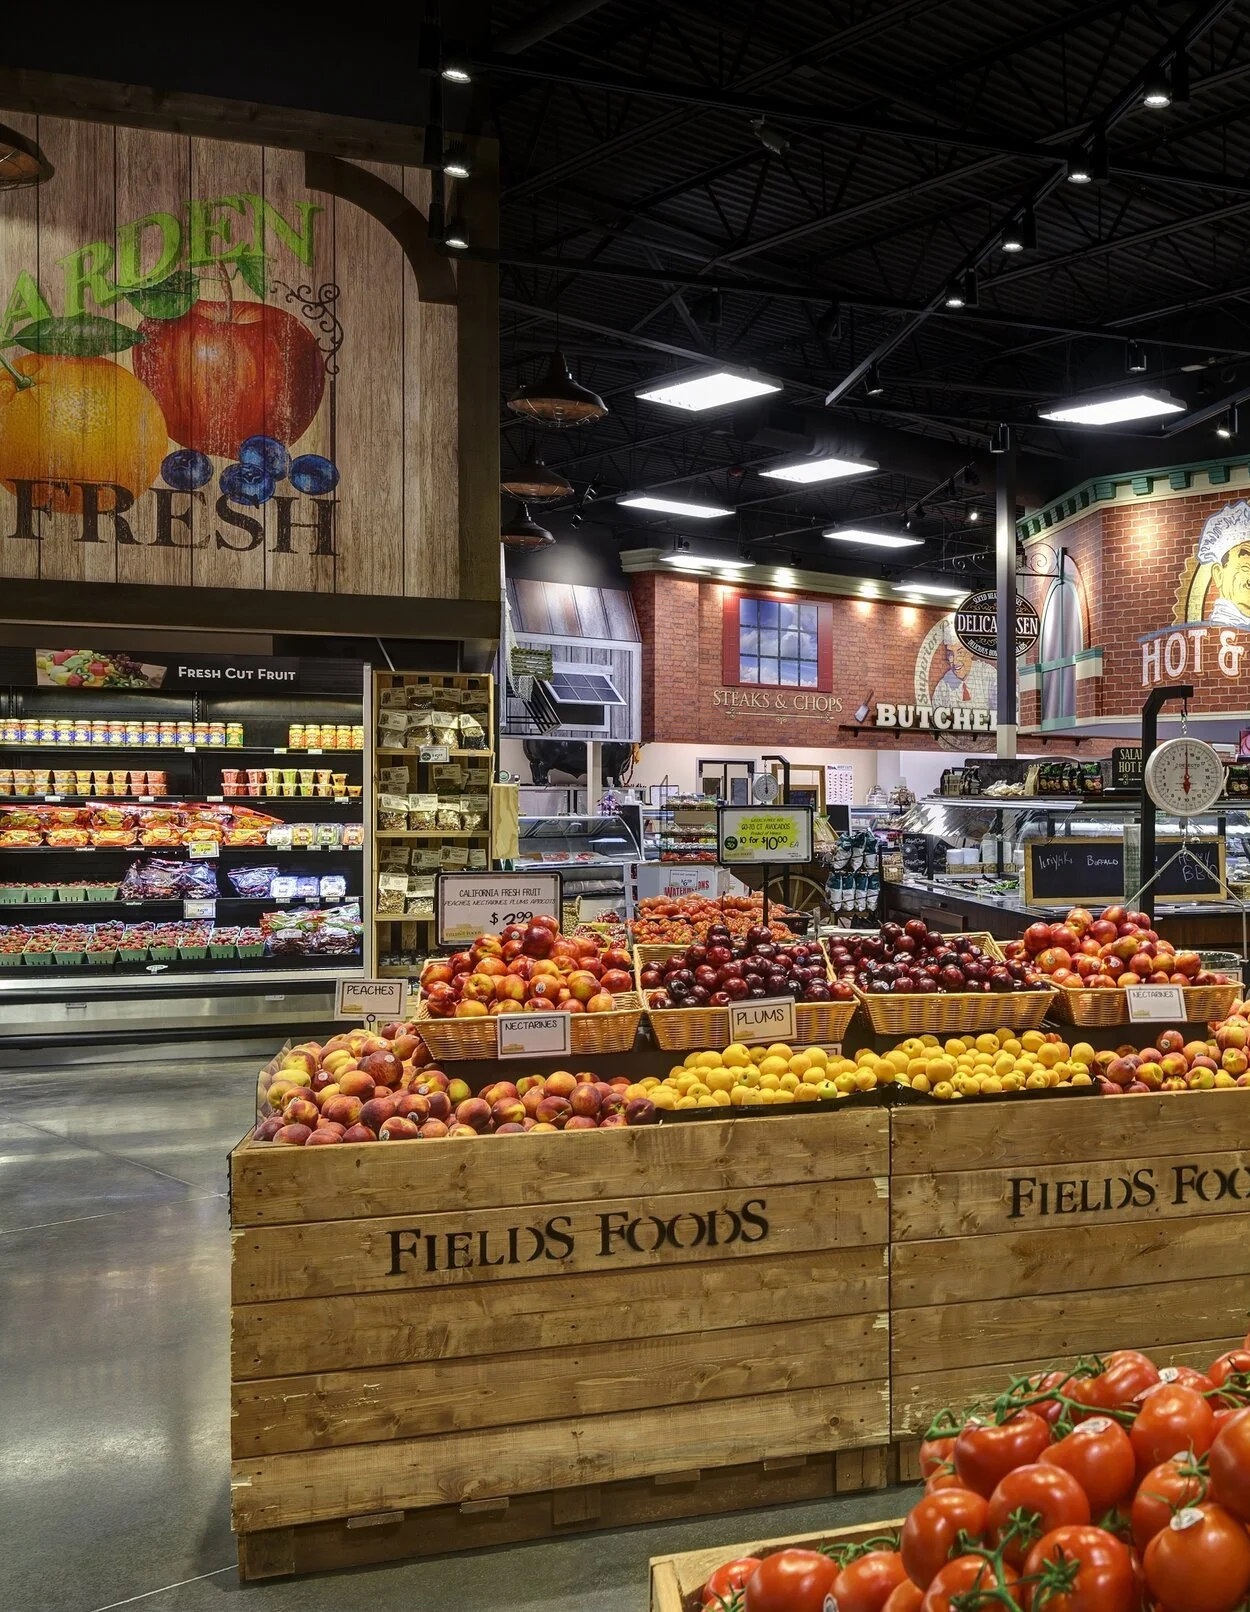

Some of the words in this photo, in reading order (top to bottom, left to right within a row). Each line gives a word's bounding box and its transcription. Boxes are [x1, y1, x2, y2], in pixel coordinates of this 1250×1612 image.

[0, 192, 324, 333] ARDEN
[6, 476, 340, 556] FRESH
[957, 614, 1039, 635] DELICASEN
[1142, 629, 1208, 688] HOT
[1218, 630, 1245, 679] &
[178, 666, 221, 678] FRESH
[225, 667, 254, 679] CUT
[258, 668, 296, 680] FRUIT
[917, 633, 938, 705] Superior
[713, 690, 770, 708] STEAKS
[775, 694, 788, 709] &
[794, 695, 843, 712] CHOPS
[1119, 761, 1135, 773] HOT
[749, 836, 759, 844] for
[459, 888, 499, 898] CALIFORNIA
[501, 888, 521, 897] FRESH
[522, 887, 542, 896] FRUIT
[346, 984, 394, 996] PEACHES
[1132, 990, 1175, 999] NECTARINES
[504, 1019, 558, 1031] NECTARINES
[736, 1008, 785, 1026] PLUMS
[1006, 1168, 1156, 1219] FIELDS
[384, 1215, 575, 1277] FIELDS
[595, 1198, 770, 1257] FOODS
